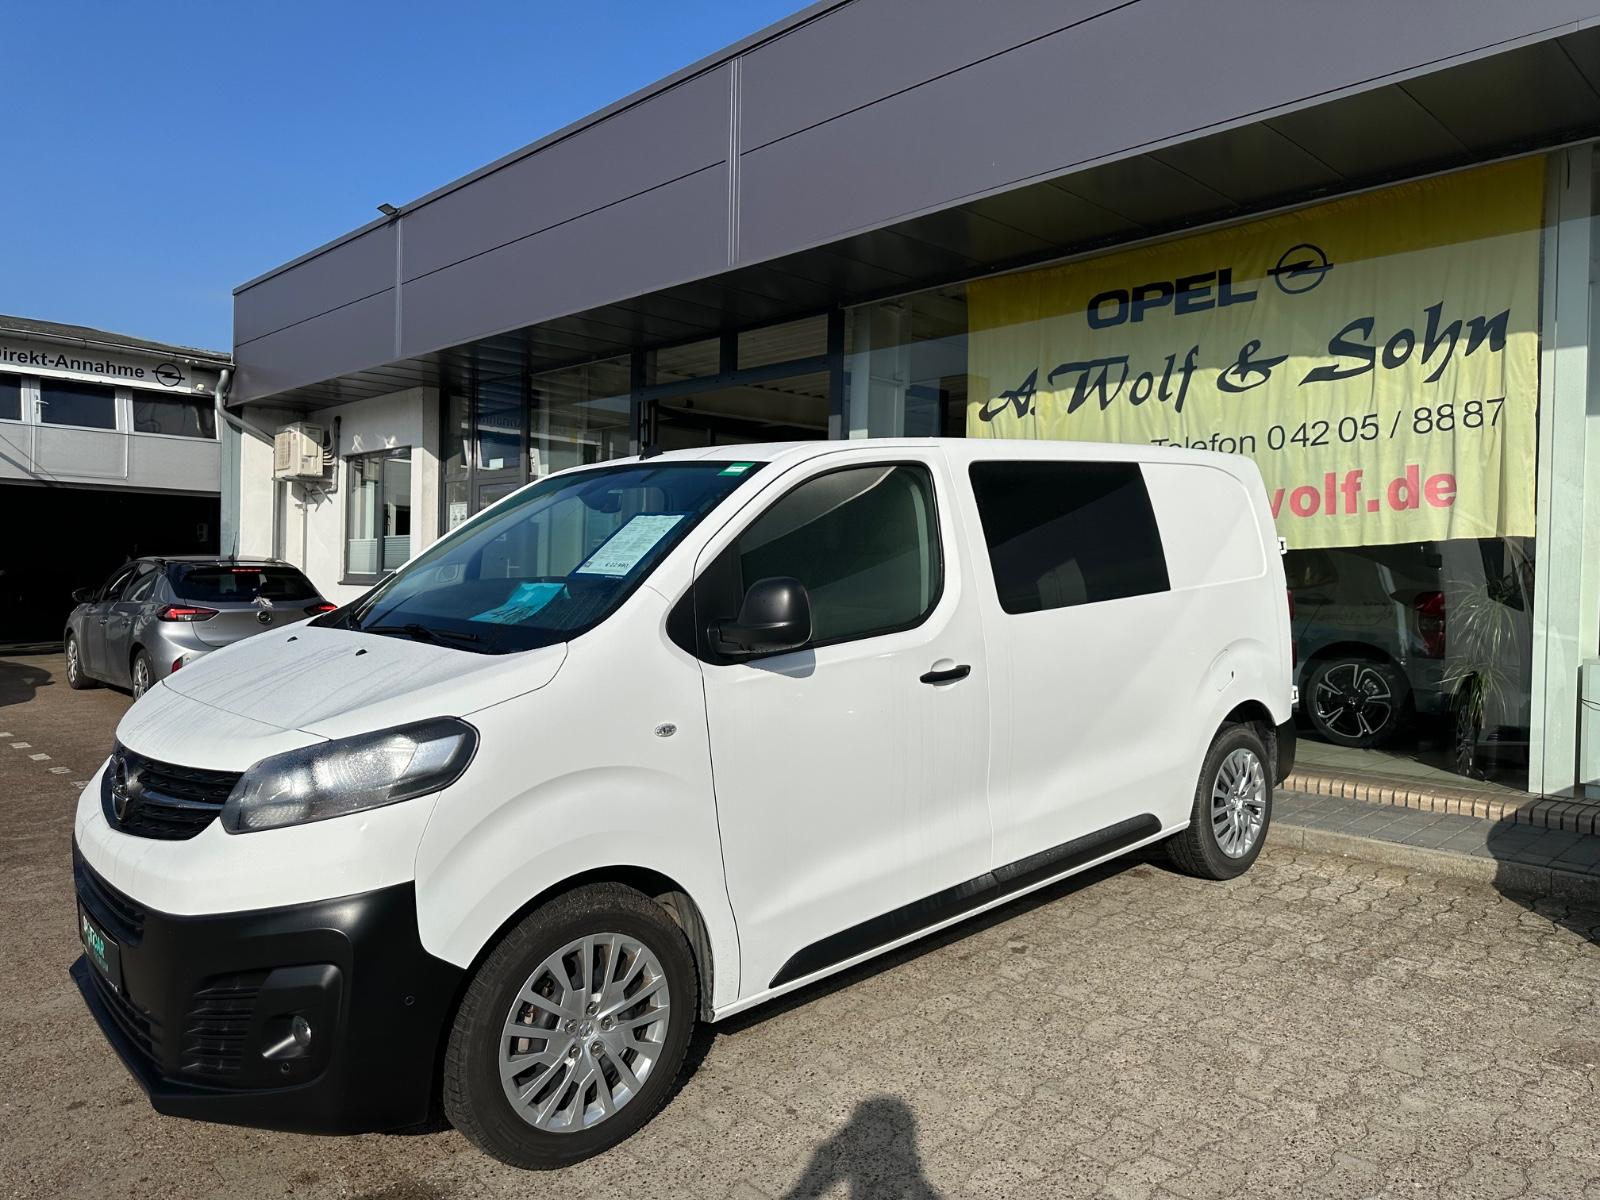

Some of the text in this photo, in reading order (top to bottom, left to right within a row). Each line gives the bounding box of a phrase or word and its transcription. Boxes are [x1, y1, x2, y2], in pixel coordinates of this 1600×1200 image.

[1087, 262, 1258, 329] OPEL
[0, 346, 145, 379] irekt-Annahme
[1217, 339, 1289, 393] &
[1297, 300, 1510, 387] Sohn
